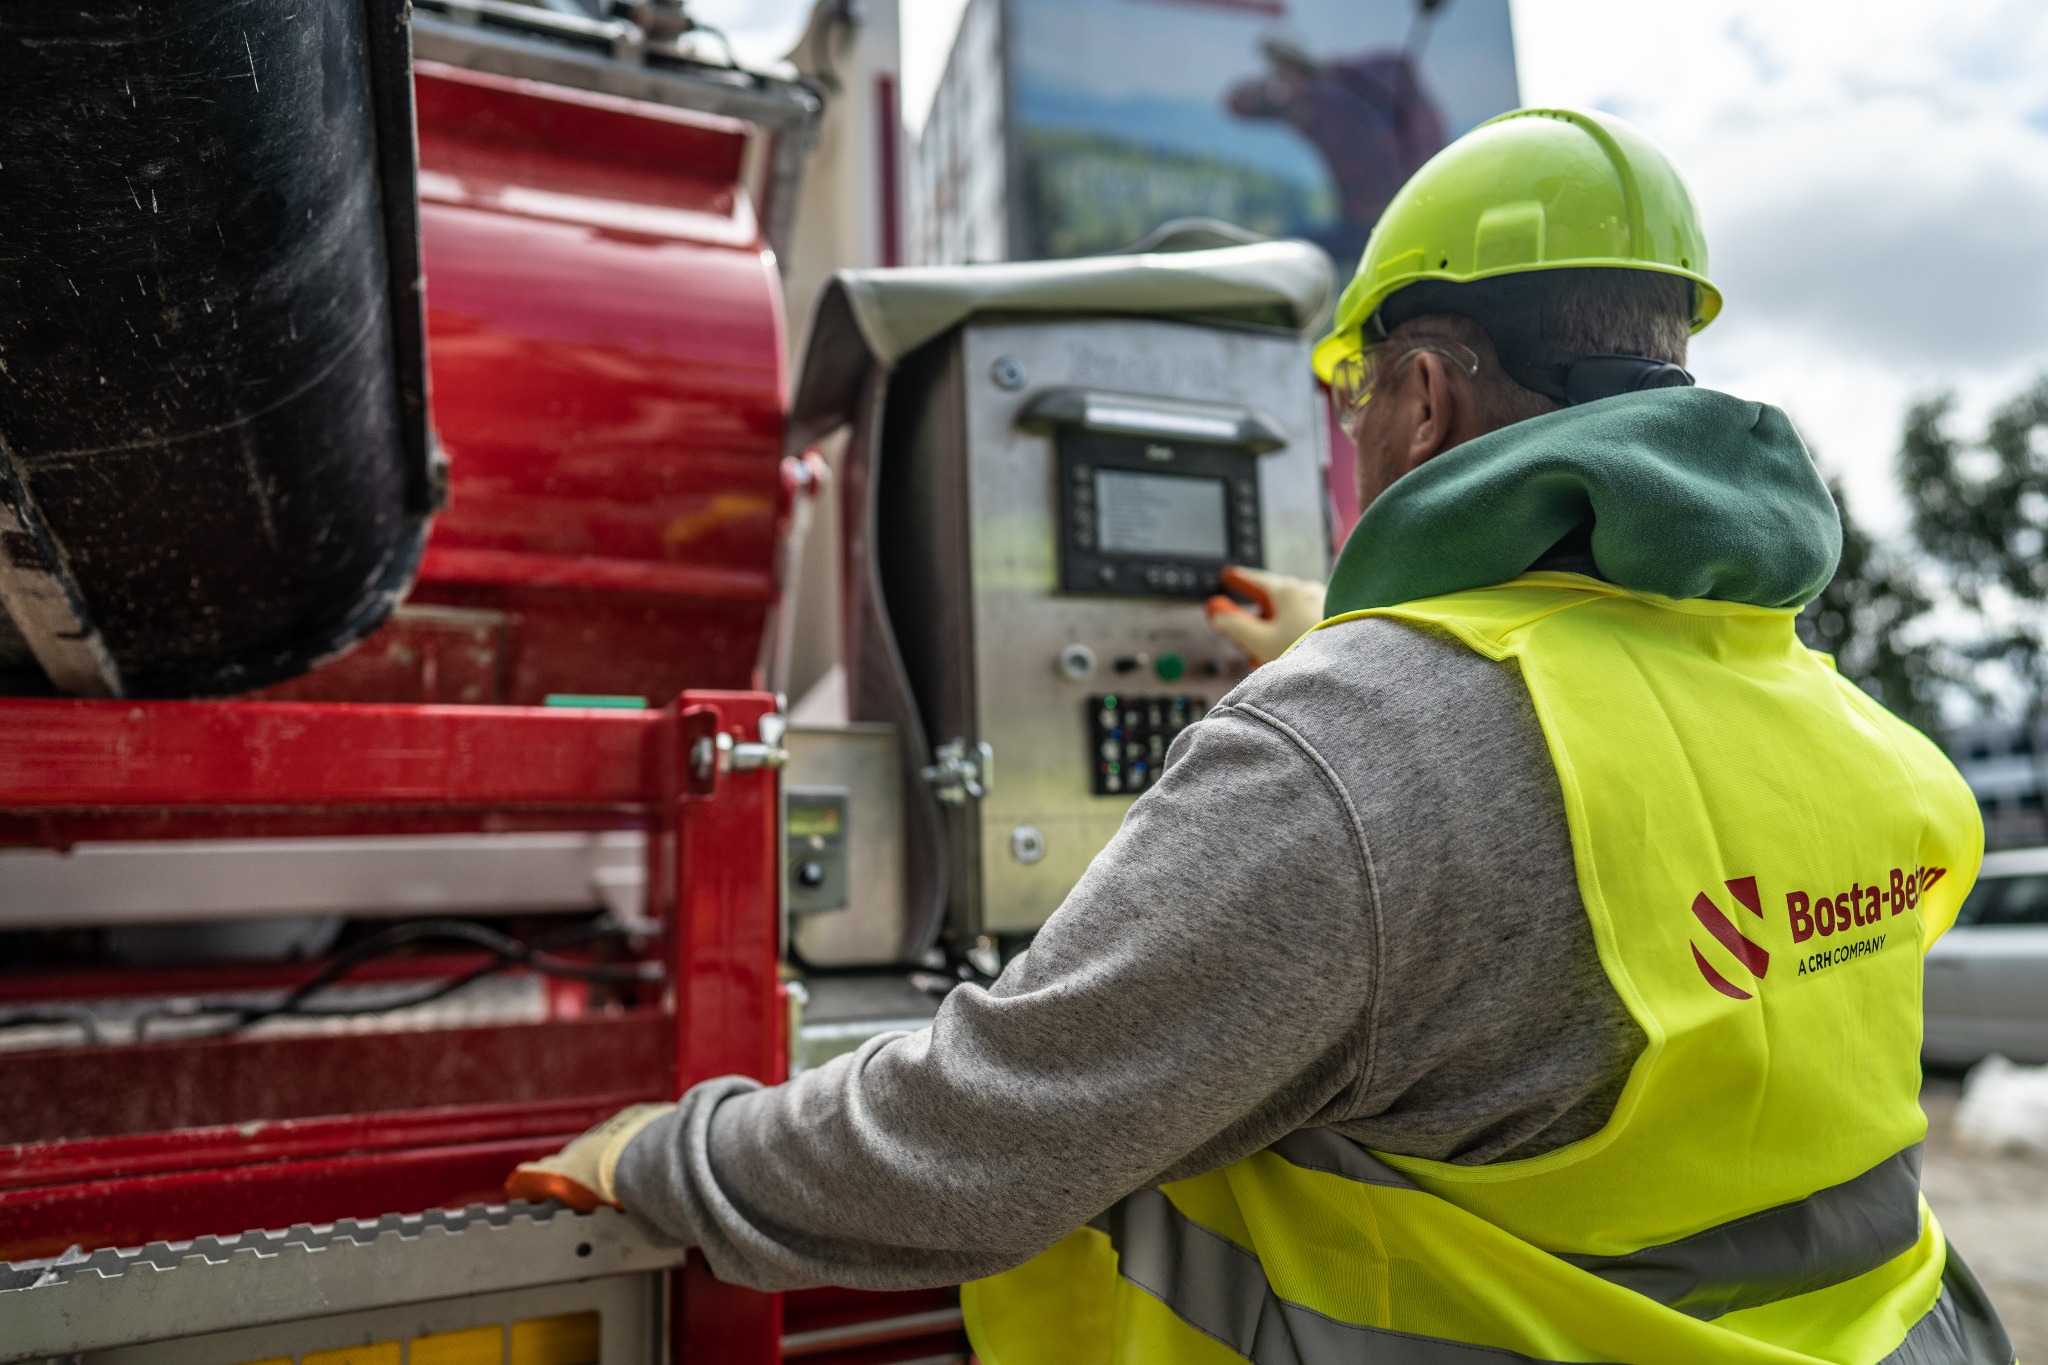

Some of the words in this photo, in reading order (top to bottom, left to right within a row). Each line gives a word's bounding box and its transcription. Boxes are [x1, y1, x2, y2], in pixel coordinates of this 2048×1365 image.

[1797, 958, 1807, 976] A
[1808, 950, 1832, 973] CRH
[1833, 933, 1887, 965] COMPANY
